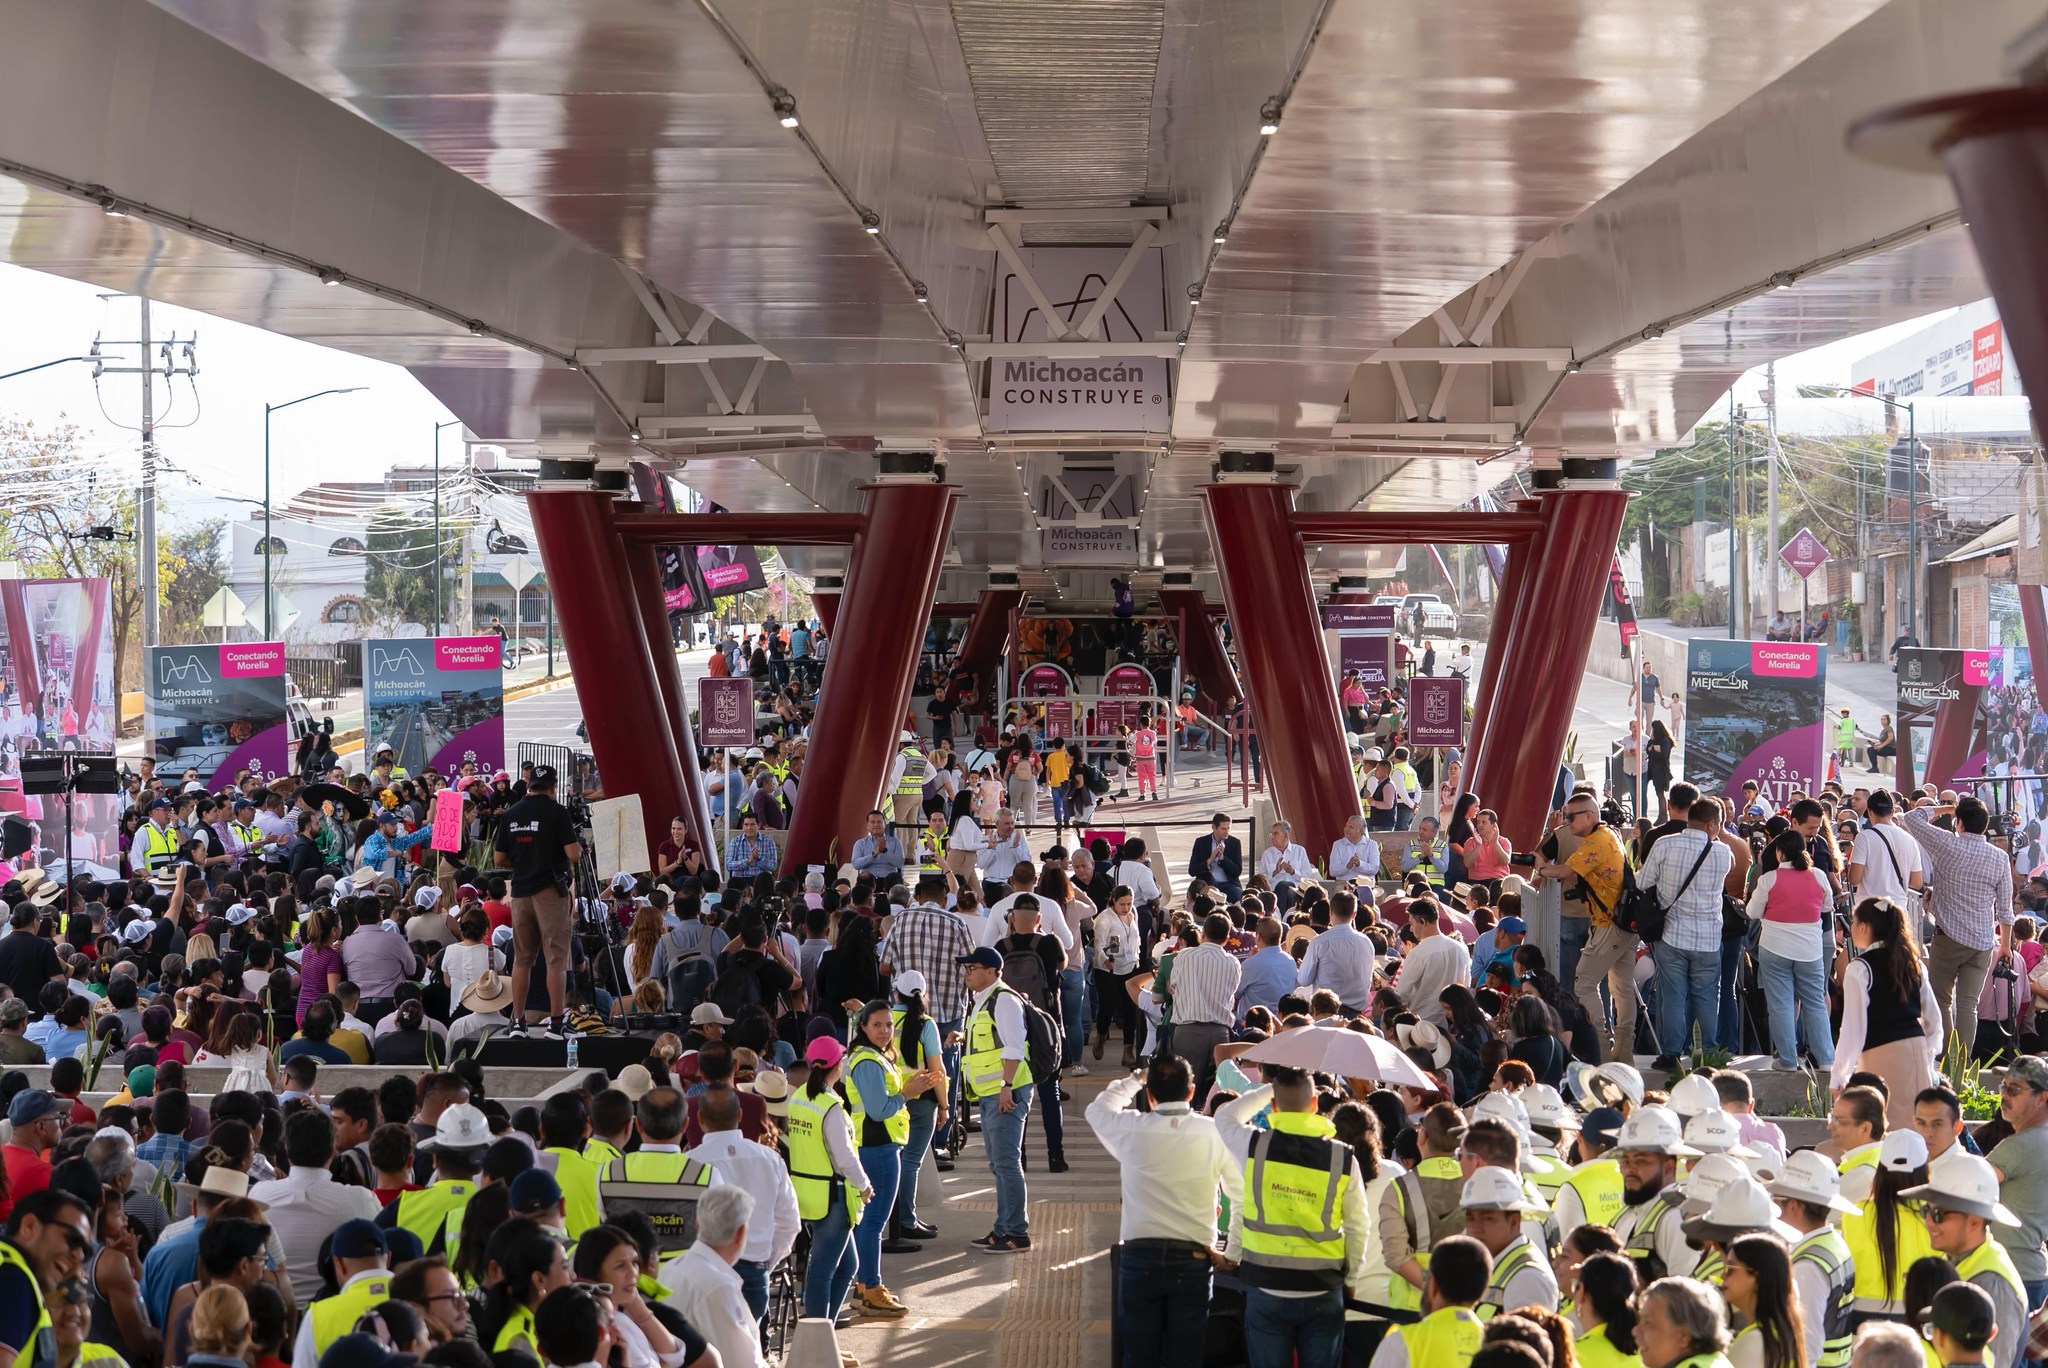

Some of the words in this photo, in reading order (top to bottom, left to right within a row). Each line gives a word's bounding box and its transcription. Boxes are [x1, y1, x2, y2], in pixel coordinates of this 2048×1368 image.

[1004, 361, 1143, 383] Michoacán
[1004, 389, 1143, 404] CONSTRUYE
[1051, 528, 1122, 540] Michoacán
[1051, 542, 1122, 551] CONSTRUYE
[442, 644, 494, 655] Conectando
[226, 651, 279, 661] Conectando
[452, 654, 485, 664] Morelia
[1759, 650, 1811, 661] Conectando
[237, 660, 269, 671] Morelia
[1768, 660, 1801, 670] Morelia
[374, 680, 426, 690] Michoacán
[162, 687, 213, 698] Michoacán
[449, 762, 491, 774] PSO
[1758, 768, 1799, 780] PASO
[1706, 1126, 1727, 1135] SCOP
[1271, 1183, 1317, 1198] Michoacán
[649, 1213, 684, 1225] oacán
